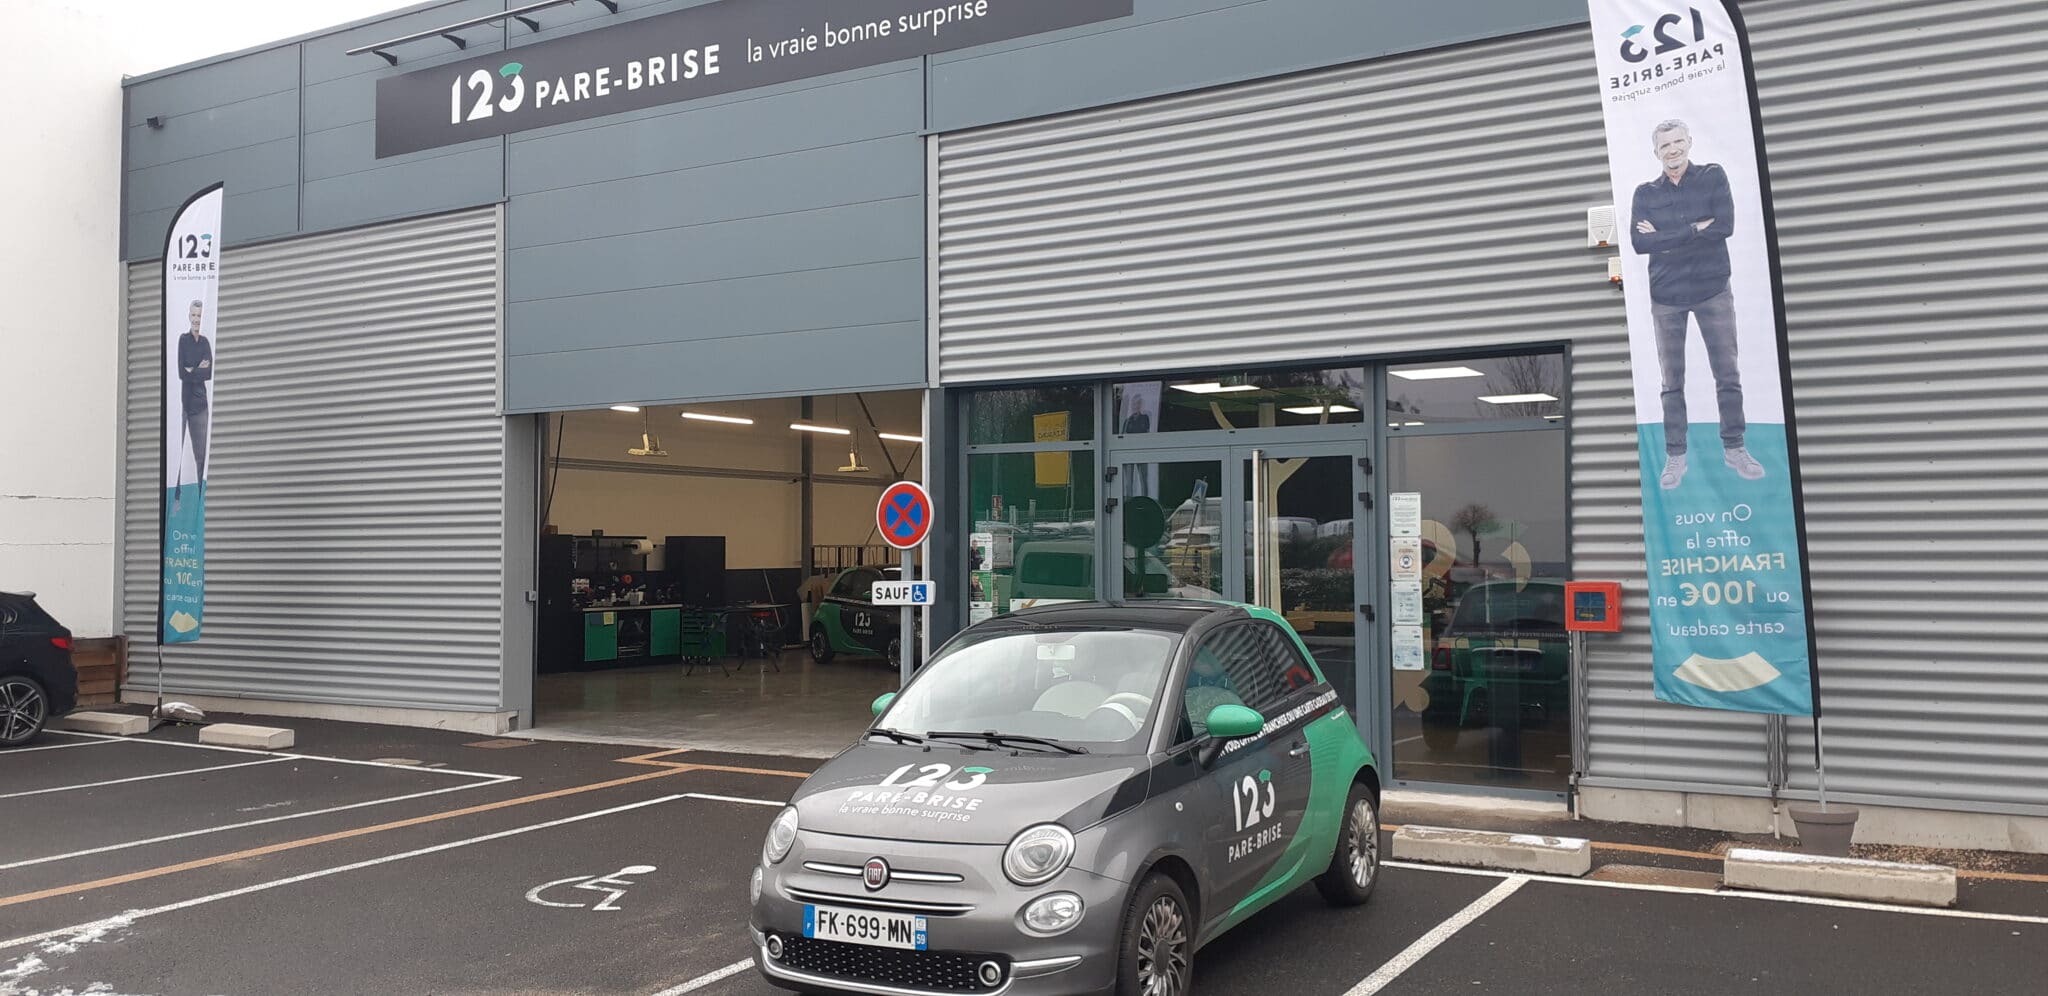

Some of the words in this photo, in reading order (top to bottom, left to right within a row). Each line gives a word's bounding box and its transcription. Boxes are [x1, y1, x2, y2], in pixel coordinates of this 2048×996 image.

[451, 62, 525, 125] 123
[535, 44, 720, 108] PARE-BRISE
[747, 38, 762, 63] la
[769, 28, 818, 58] vraie
[825, 22, 891, 48] bonne
[898, 0, 989, 36] surprise
[179, 234, 212, 258] 123
[876, 587, 910, 600] SAUF
[878, 763, 995, 791] 123
[838, 802, 849, 814] la
[852, 804, 879, 815] vraie
[881, 803, 919, 816] bonne
[921, 808, 971, 823] surprise
[847, 790, 984, 811] PARE-BRISE
[1233, 769, 1275, 832] 123
[1228, 822, 1282, 863] PARE-BRISE
[868, 867, 882, 881] FIAT
[818, 910, 911, 944] FK-699-MN
[916, 933, 926, 945] 59
